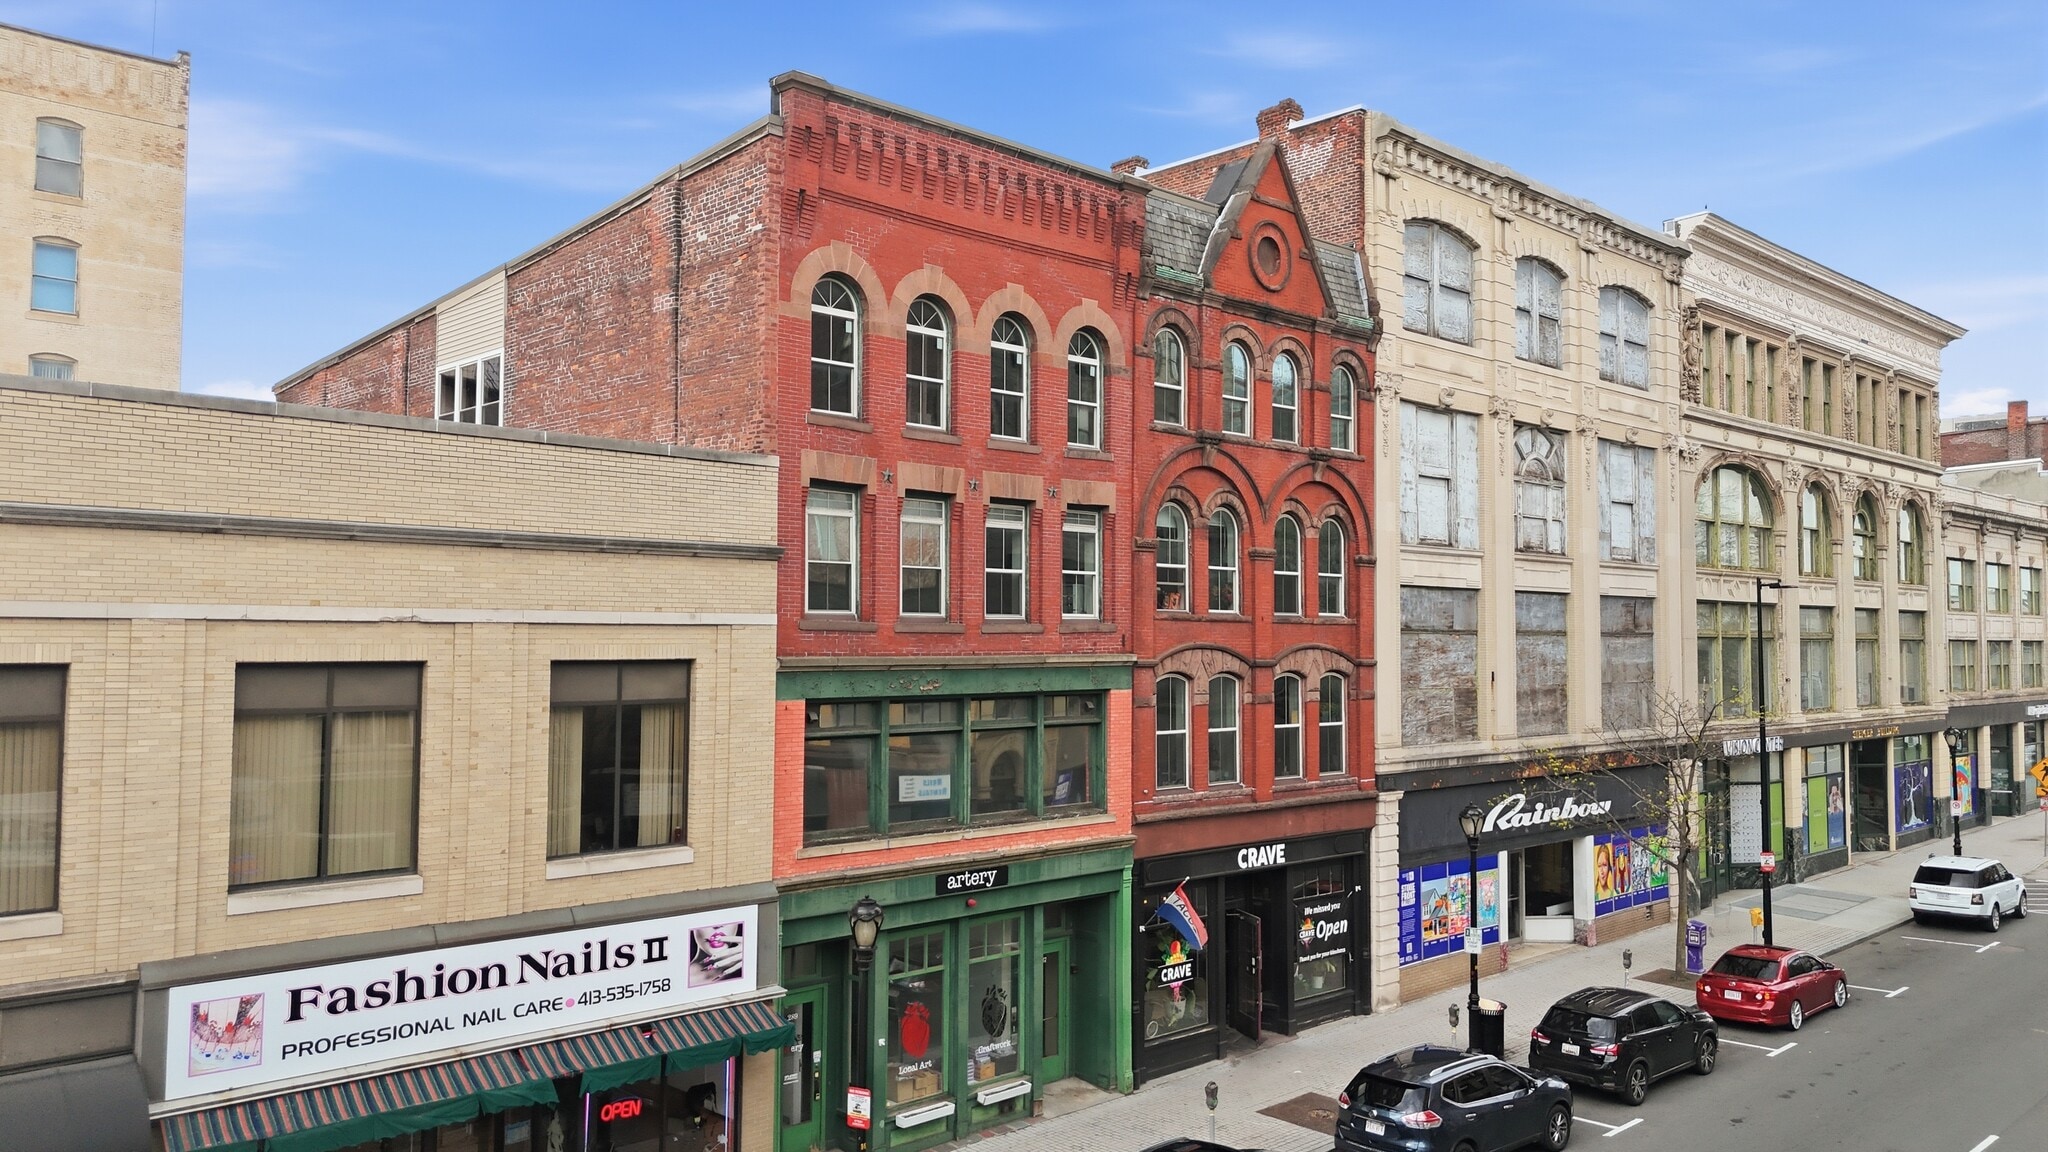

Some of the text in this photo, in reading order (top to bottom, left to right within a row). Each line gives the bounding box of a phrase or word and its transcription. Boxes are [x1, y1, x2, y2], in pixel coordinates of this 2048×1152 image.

[1481, 794, 1612, 832] Rainbow
[1237, 843, 1286, 869] CRAVE
[947, 870, 998, 889] artery
[1313, 902, 1331, 914] missed
[1331, 902, 1341, 913] you
[1316, 919, 1348, 942] Open
[284, 962, 509, 1024] Fashion
[516, 939, 636, 985] Nails
[1161, 963, 1192, 982] CRAVE
[281, 977, 672, 1060] PROFESSIONAL NAIL CARE 413-535-1758
[898, 1060, 933, 1075] Local Art
[600, 1098, 642, 1122] OPEN
